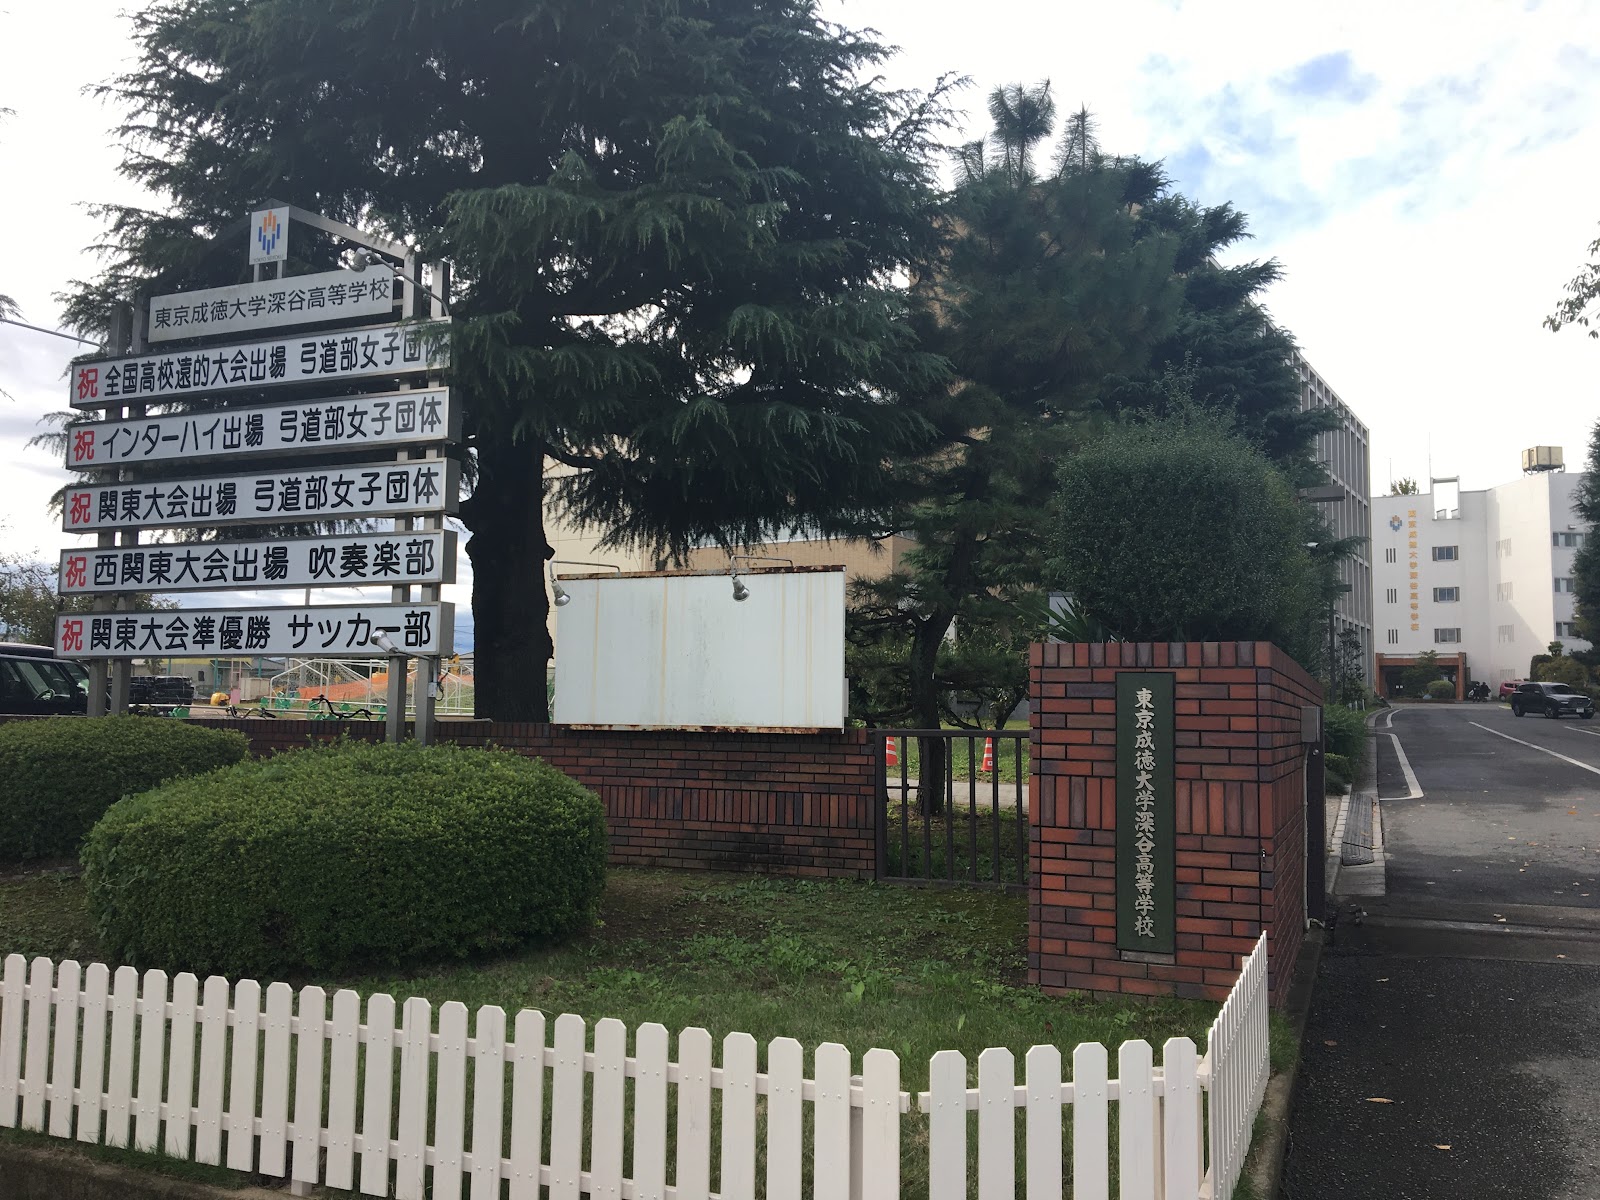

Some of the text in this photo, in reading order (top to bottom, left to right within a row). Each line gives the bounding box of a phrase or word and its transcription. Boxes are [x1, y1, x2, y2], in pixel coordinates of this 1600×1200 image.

[155, 276, 391, 330] 東京成徳大学深谷高等学校
[77, 367, 98, 400] 祝
[104, 344, 287, 397] 全国高校遠的大会出場
[73, 395, 442, 462] 祝 インターハイ出場 弓道部女子団体
[70, 466, 439, 525] 祝 関東大会出場 弓道部女子団体
[66, 538, 434, 588] 祝 西関東大会出場 吹奏楽部
[61, 610, 431, 652] 祝 関東大会準優勝 サッカー部
[1134, 687, 1156, 938] 東京成徳大学深谷高等学校
